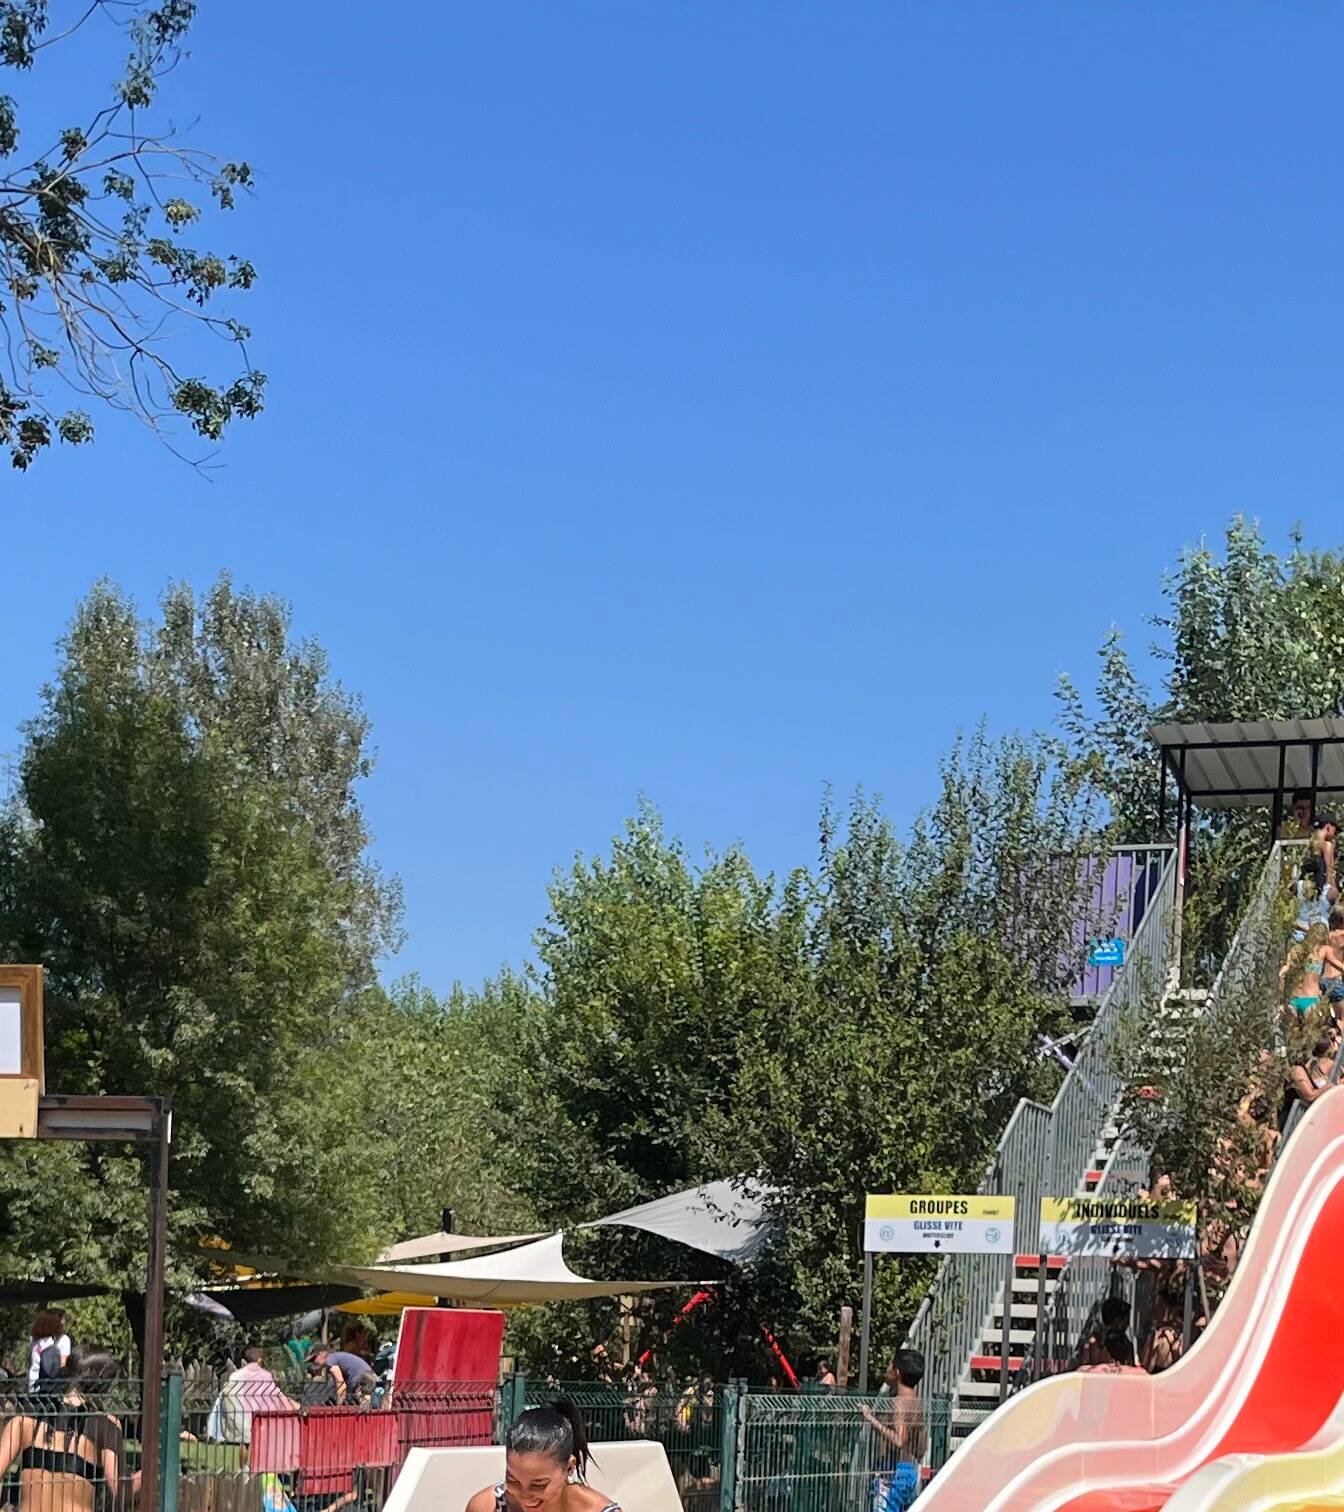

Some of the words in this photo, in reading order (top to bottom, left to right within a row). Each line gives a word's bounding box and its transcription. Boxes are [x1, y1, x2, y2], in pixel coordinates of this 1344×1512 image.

[910, 1199, 968, 1215] GROUPES
[1076, 1203, 1160, 1219] INDIVIDUELS
[914, 1221, 943, 1231] GLISSE
[944, 1221, 964, 1231] VITE
